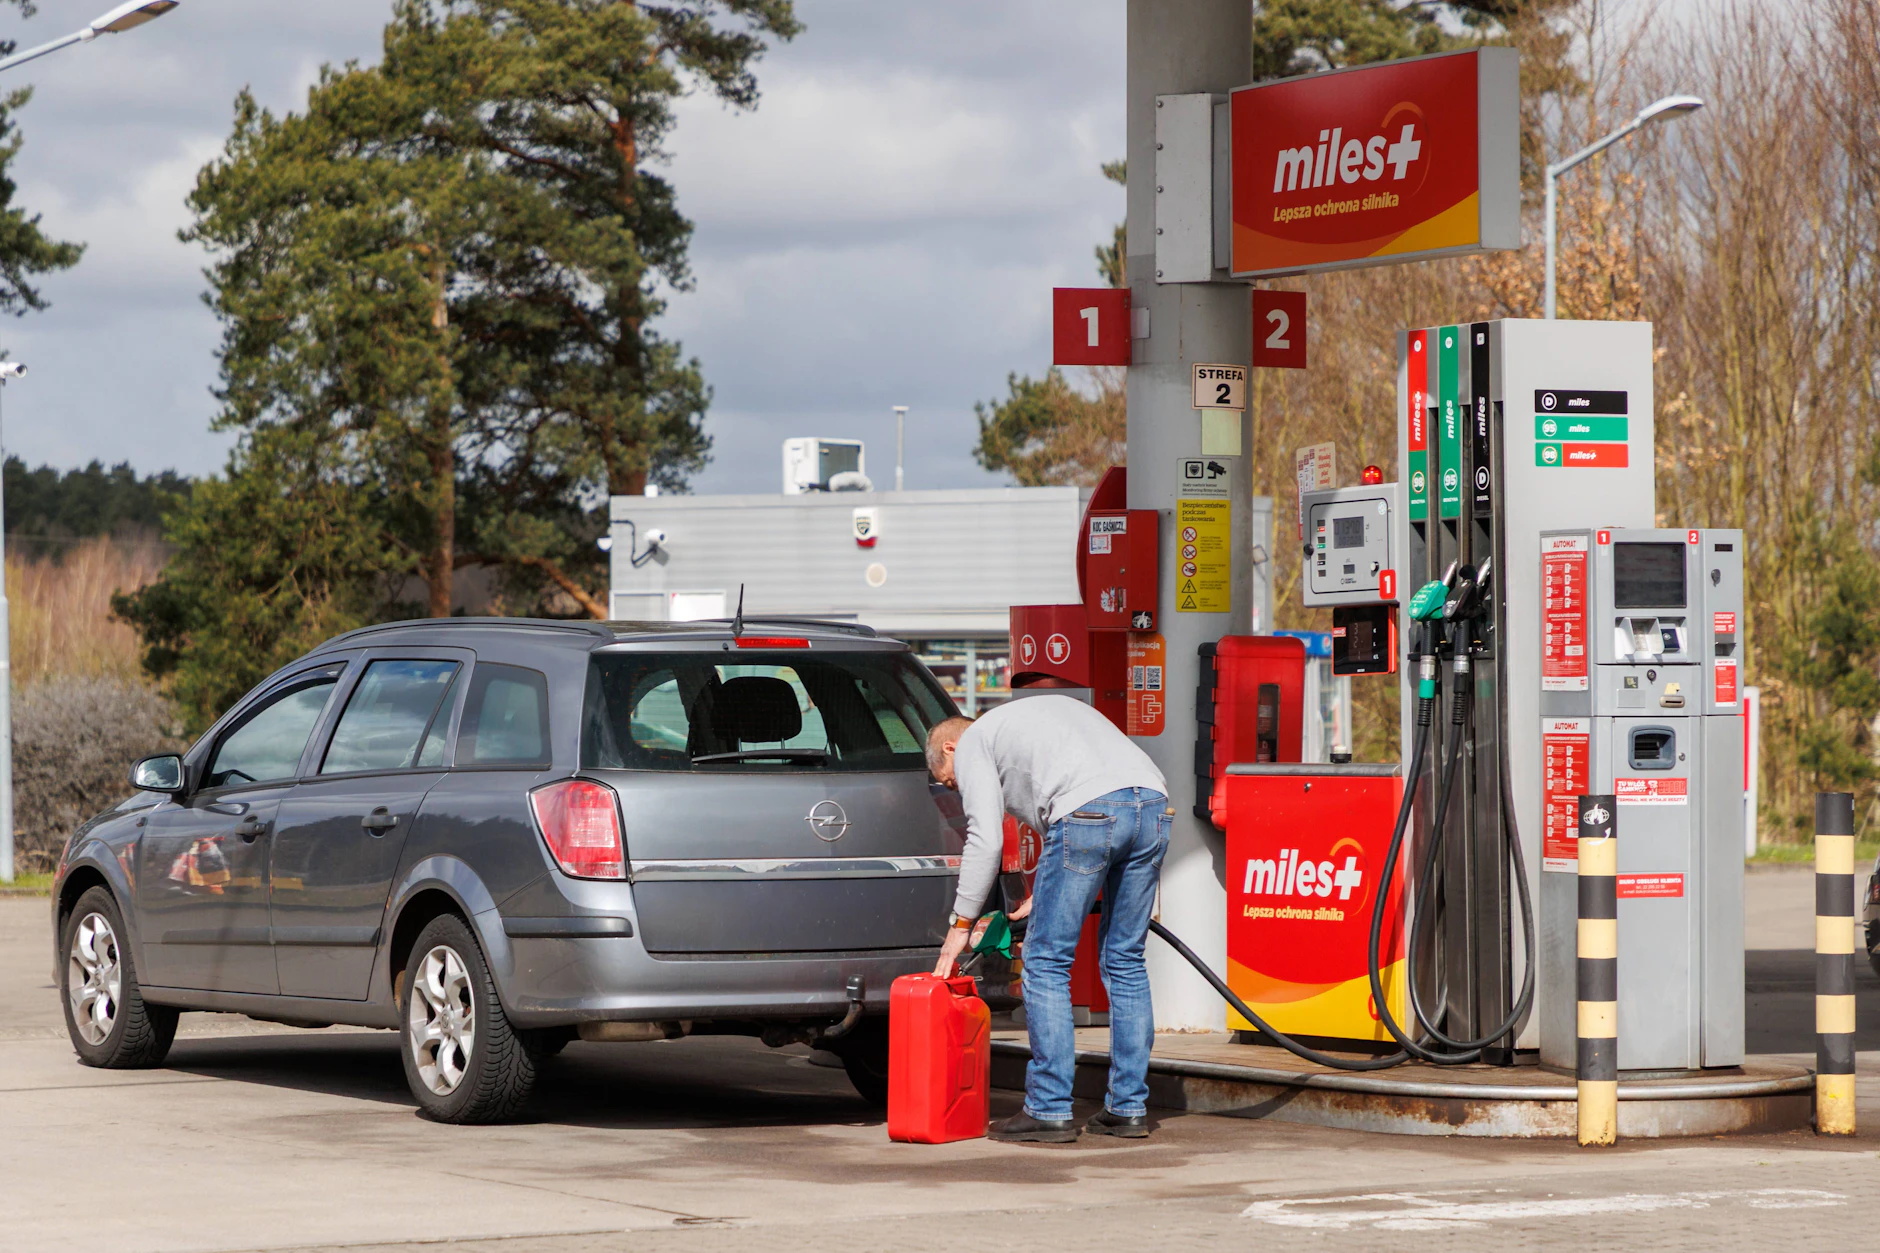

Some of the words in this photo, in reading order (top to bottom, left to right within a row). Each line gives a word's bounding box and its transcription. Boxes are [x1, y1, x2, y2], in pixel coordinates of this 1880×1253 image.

[1273, 124, 1422, 193] miles+
[1273, 204, 1312, 224] Lepsza
[1314, 198, 1360, 216] ochrona
[1362, 192, 1400, 211] silnika
[1080, 306, 1099, 346] 1
[1266, 308, 1290, 349] 2
[1198, 368, 1244, 382] STREFA
[1216, 383, 1231, 404] 2
[1544, 396, 1554, 406] D
[1568, 398, 1590, 406] miles
[1446, 400, 1454, 438] miles
[1478, 396, 1486, 436] miles
[1544, 424, 1556, 432] 95
[1568, 424, 1590, 432] miles
[1544, 450, 1556, 458] 98
[1570, 450, 1596, 460] miles+
[1414, 476, 1423, 488] 98
[1445, 474, 1456, 486] 95
[1478, 474, 1486, 484] D
[1093, 521, 1102, 532] KOC
[1601, 533, 1606, 542] 1
[1691, 533, 1696, 542] 2
[1384, 575, 1391, 593] 1
[1243, 848, 1362, 900] miles+
[1243, 904, 1274, 920] Lepsza
[1276, 906, 1312, 920] ochrona
[1314, 907, 1344, 921] silnika
